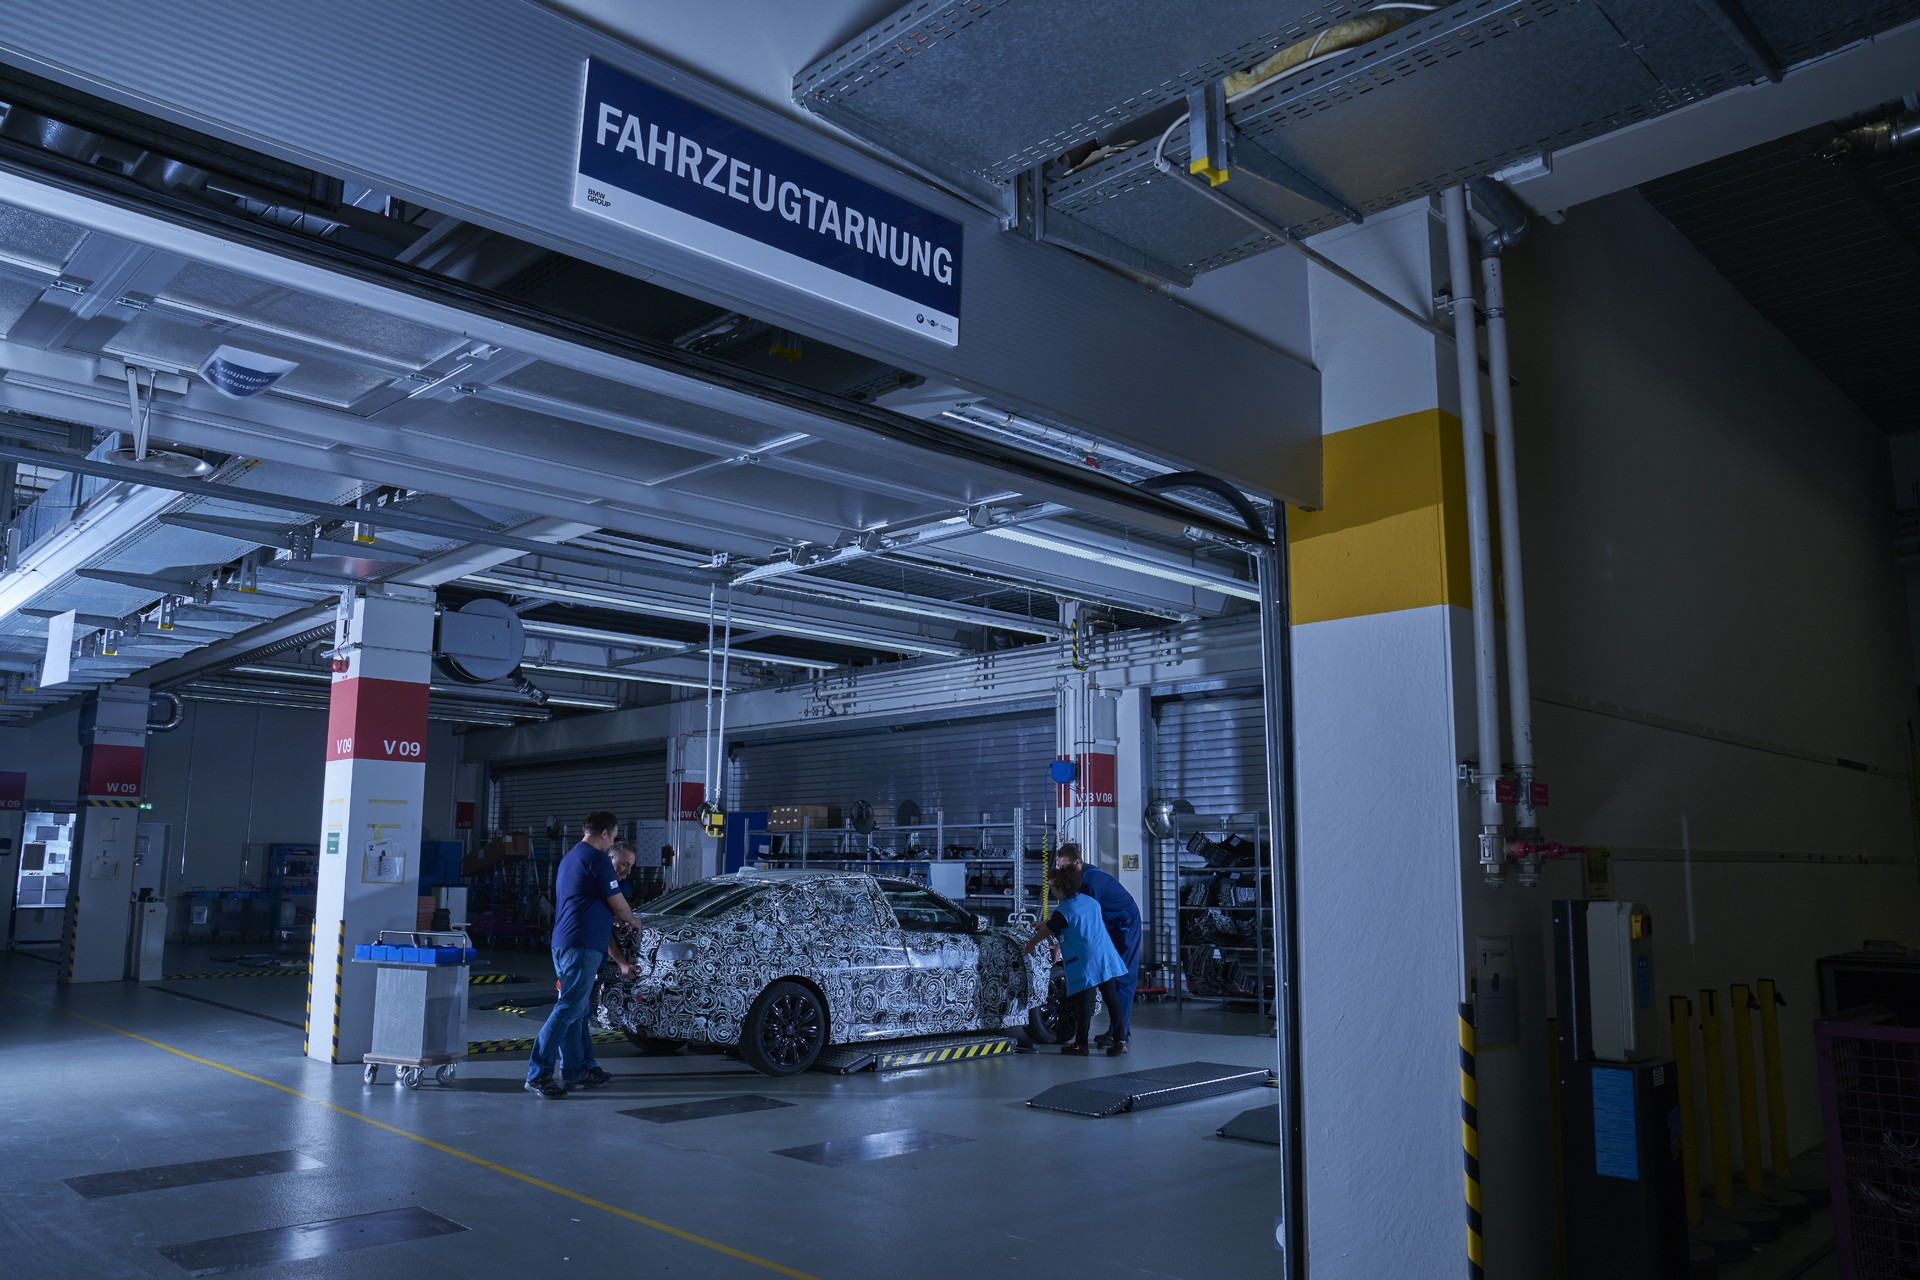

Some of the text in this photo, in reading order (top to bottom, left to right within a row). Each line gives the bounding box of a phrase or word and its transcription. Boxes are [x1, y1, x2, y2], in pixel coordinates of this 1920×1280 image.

[588, 188, 606, 200] BMW
[596, 101, 953, 286] FAHRZEUGTARNUNG
[587, 194, 612, 208] GROUP
[336, 738, 352, 754] V 09
[383, 740, 420, 756] V 09
[106, 782, 136, 793] W 09
[7, 800, 21, 808] 09
[1096, 792, 1112, 802] V 08
[1482, 952, 1488, 966] 1
